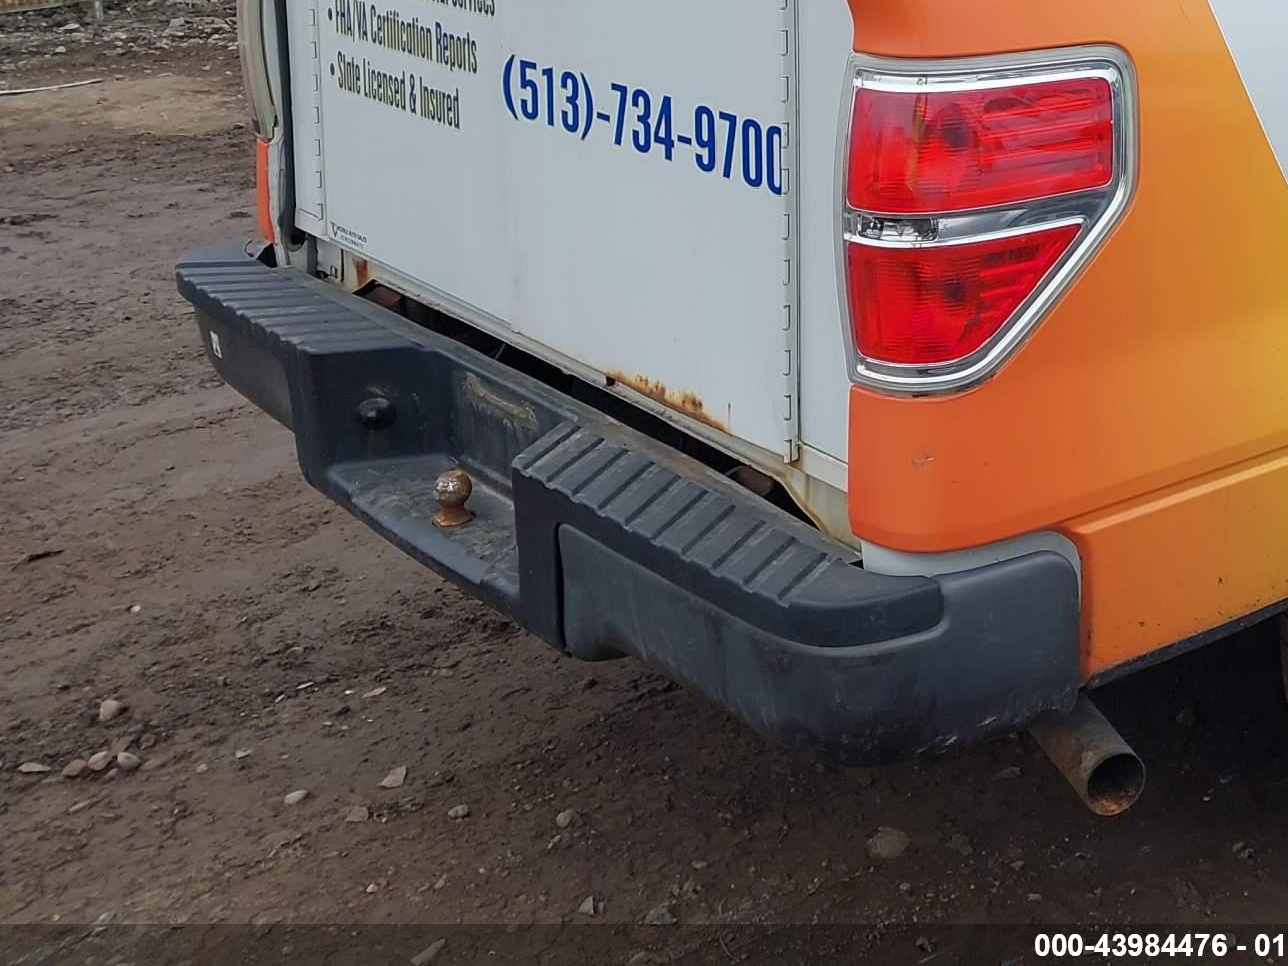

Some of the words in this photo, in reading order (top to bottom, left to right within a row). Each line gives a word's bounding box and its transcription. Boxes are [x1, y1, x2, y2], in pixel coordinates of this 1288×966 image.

[370, 4, 433, 62] Certification
[435, 21, 478, 74] Reports
[337, 50, 361, 95] State
[363, 57, 406, 111] Licensed
[409, 74, 417, 115] &
[419, 76, 460, 130] Insured
[502, 54, 782, 196] (513)-734-9700
